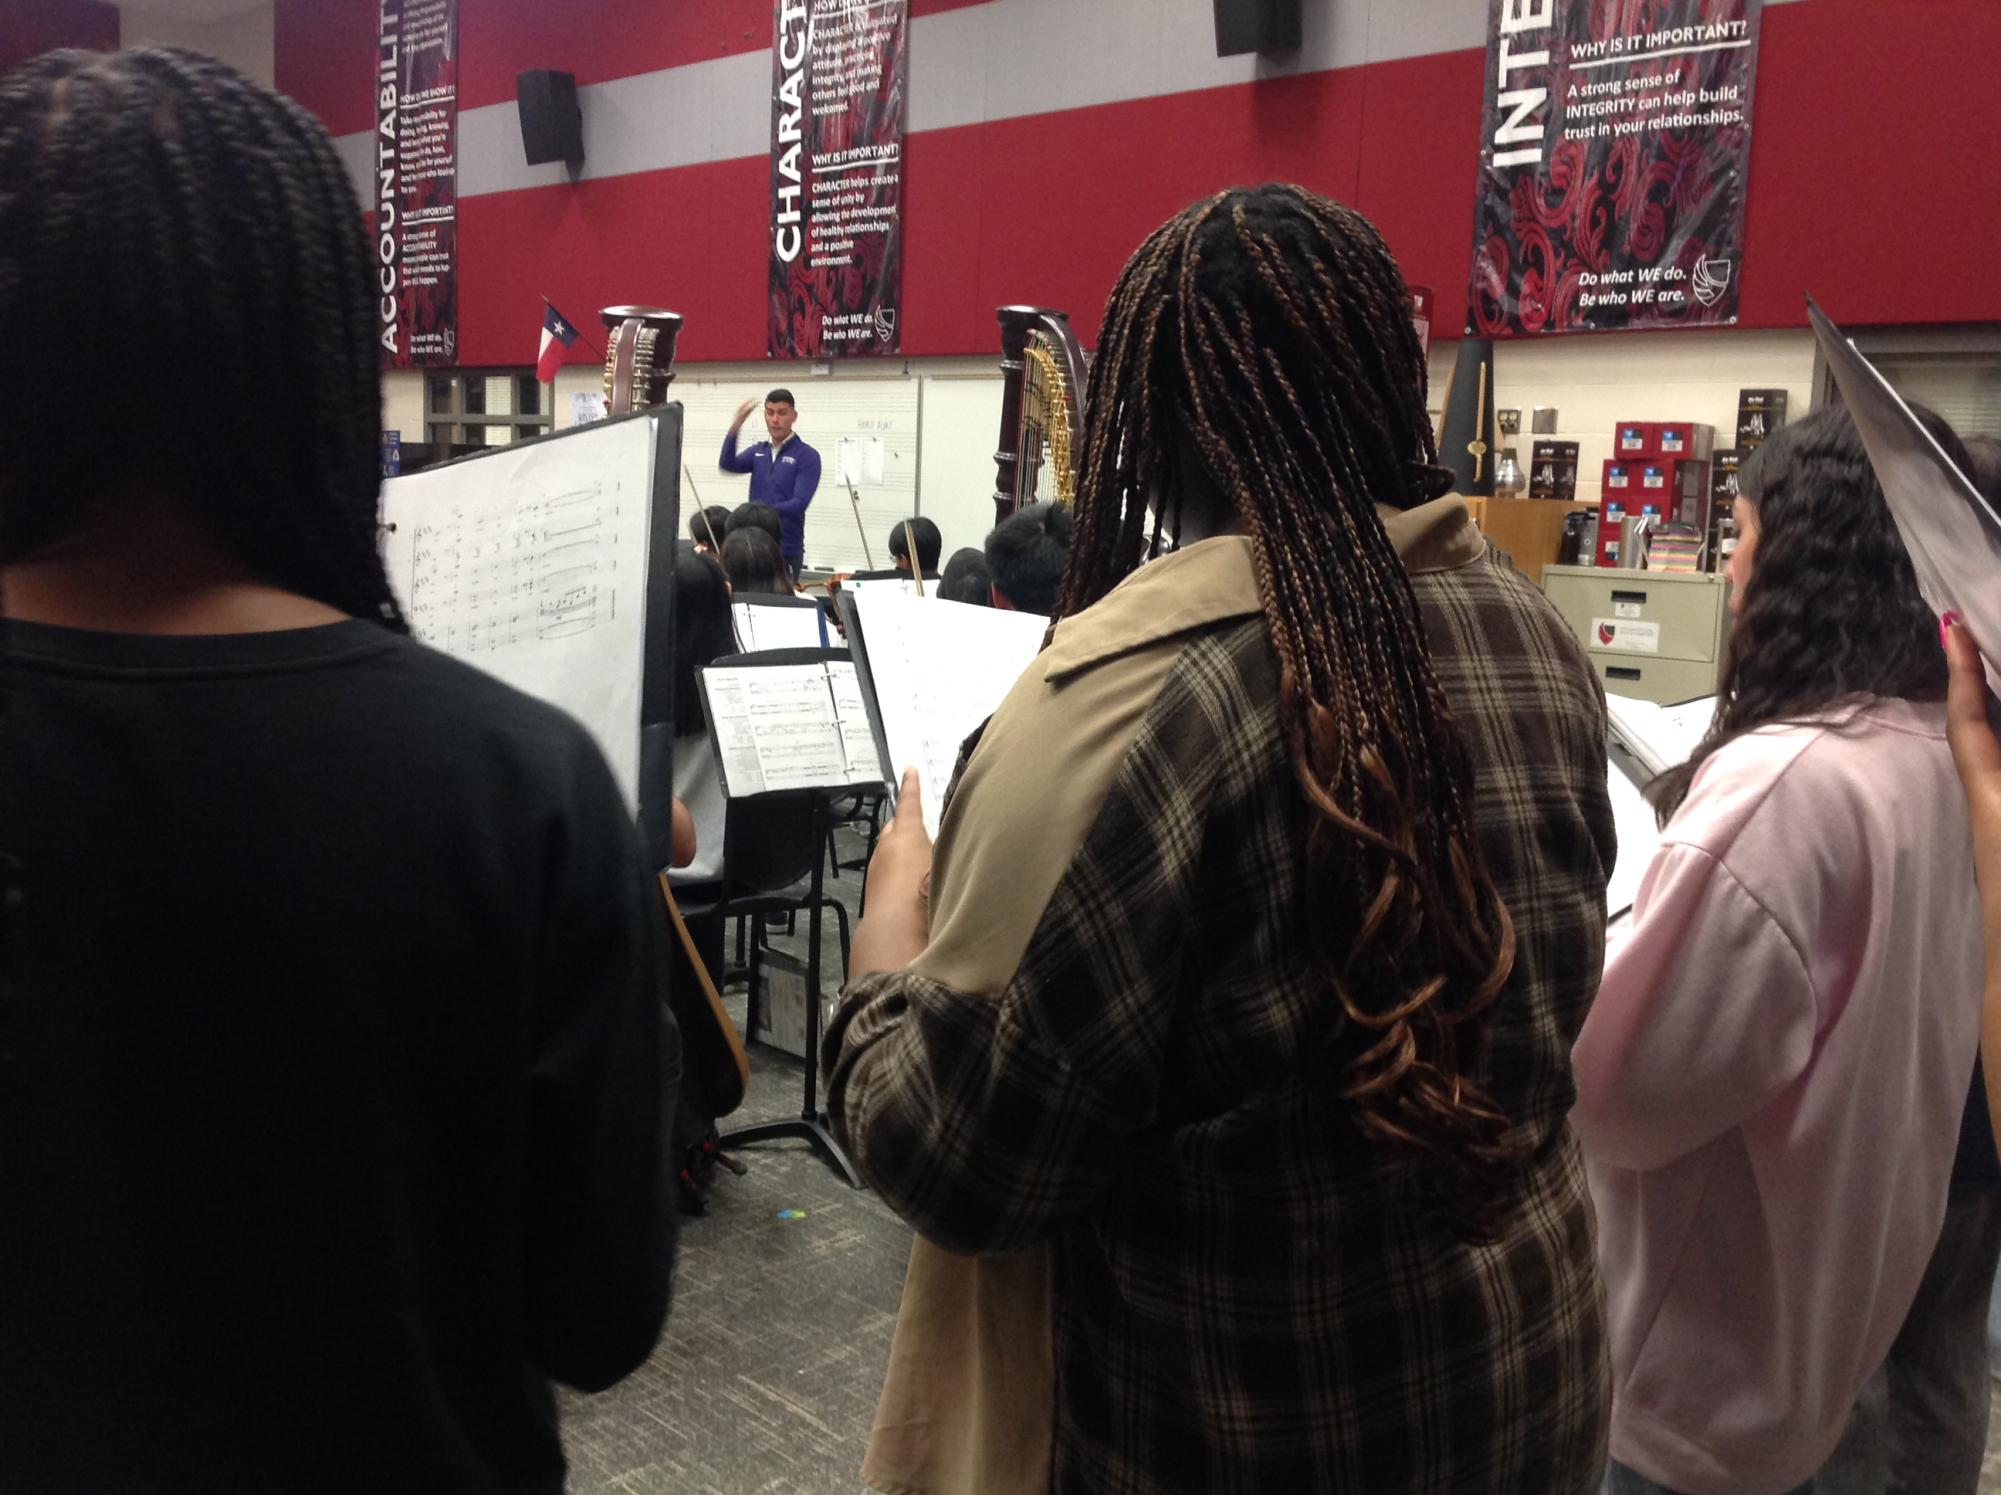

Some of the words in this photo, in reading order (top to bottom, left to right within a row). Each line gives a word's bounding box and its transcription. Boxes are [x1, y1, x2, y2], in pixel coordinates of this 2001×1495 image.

[1571, 40, 1607, 59] WHY
[1611, 37, 1623, 52] IS
[1627, 35, 1642, 51] IT
[1646, 20, 1747, 48] IMPORTANT?
[812, 44, 823, 56] by
[812, 88, 836, 101] others
[865, 77, 880, 91] and
[1493, 0, 1553, 167] INTE
[1567, 84, 1577, 98] A
[1581, 79, 1621, 97] strong
[1625, 75, 1662, 90] sense
[1665, 68, 1681, 84] of
[1566, 98, 1635, 119] INTEGRITY
[1638, 96, 1660, 111] can
[1664, 89, 1696, 107] help
[1699, 85, 1738, 102] build
[1564, 125, 1595, 140] trust
[1599, 123, 1610, 136] in
[1614, 119, 1645, 137] your
[1647, 108, 1744, 131] relationships.
[812, 152, 832, 166] WHY
[832, 151, 841, 163] IS
[841, 151, 848, 162] IT
[848, 143, 899, 160] IMPORTANT?
[380, 0, 398, 354] ACCOUNTABILIT
[812, 178, 850, 194] CHARACTER
[851, 175, 869, 188] helps
[870, 175, 894, 187] create
[812, 198, 831, 208] sense
[832, 195, 840, 206] of
[841, 194, 854, 206] unity
[855, 191, 865, 203] by
[811, 211, 841, 223] allowing
[841, 208, 849, 219] the
[429, 228, 436, 238] of
[811, 227, 819, 238] of
[820, 224, 844, 238] healthy
[845, 220, 890, 236] relationships
[811, 241, 823, 252] and
[824, 243, 829, 251] a
[830, 239, 854, 253] positive
[811, 254, 853, 267] environment.
[1578, 272, 1597, 286] Do
[1600, 269, 1634, 285] what
[1638, 267, 1660, 282] WE
[1664, 265, 1687, 281] do.
[1579, 292, 1596, 307] Be
[1599, 290, 1627, 305] who
[1631, 289, 1656, 303] WE
[1657, 289, 1685, 302] are.
[822, 315, 832, 325] Do
[833, 314, 849, 325] what
[850, 313, 863, 324] WE
[823, 329, 832, 340] Be
[833, 329, 846, 339] who
[848, 328, 860, 339] WE
[861, 329, 873, 338] are.
